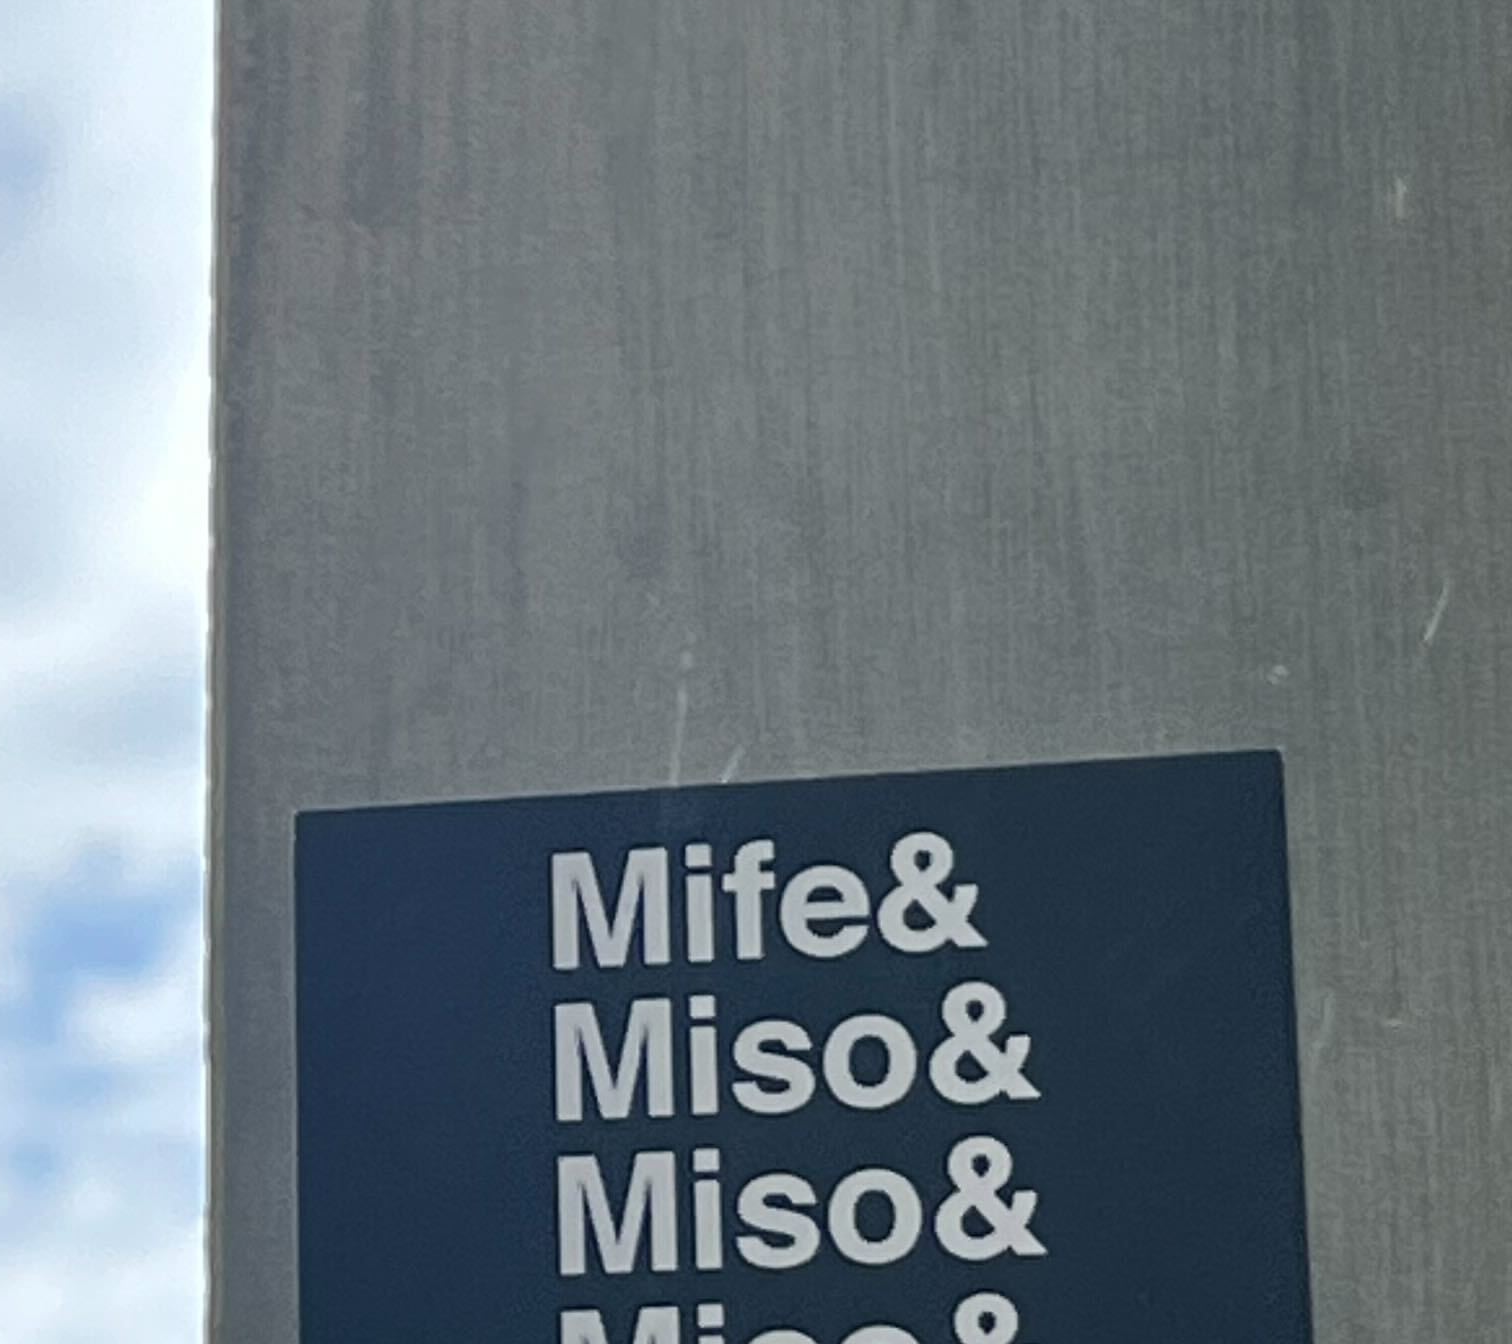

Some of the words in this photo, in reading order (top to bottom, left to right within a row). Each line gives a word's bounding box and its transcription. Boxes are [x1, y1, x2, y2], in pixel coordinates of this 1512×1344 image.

[551, 832, 988, 971] Mife&
[554, 981, 1042, 1122] Miso&
[556, 1135, 1048, 1276] Miso&
